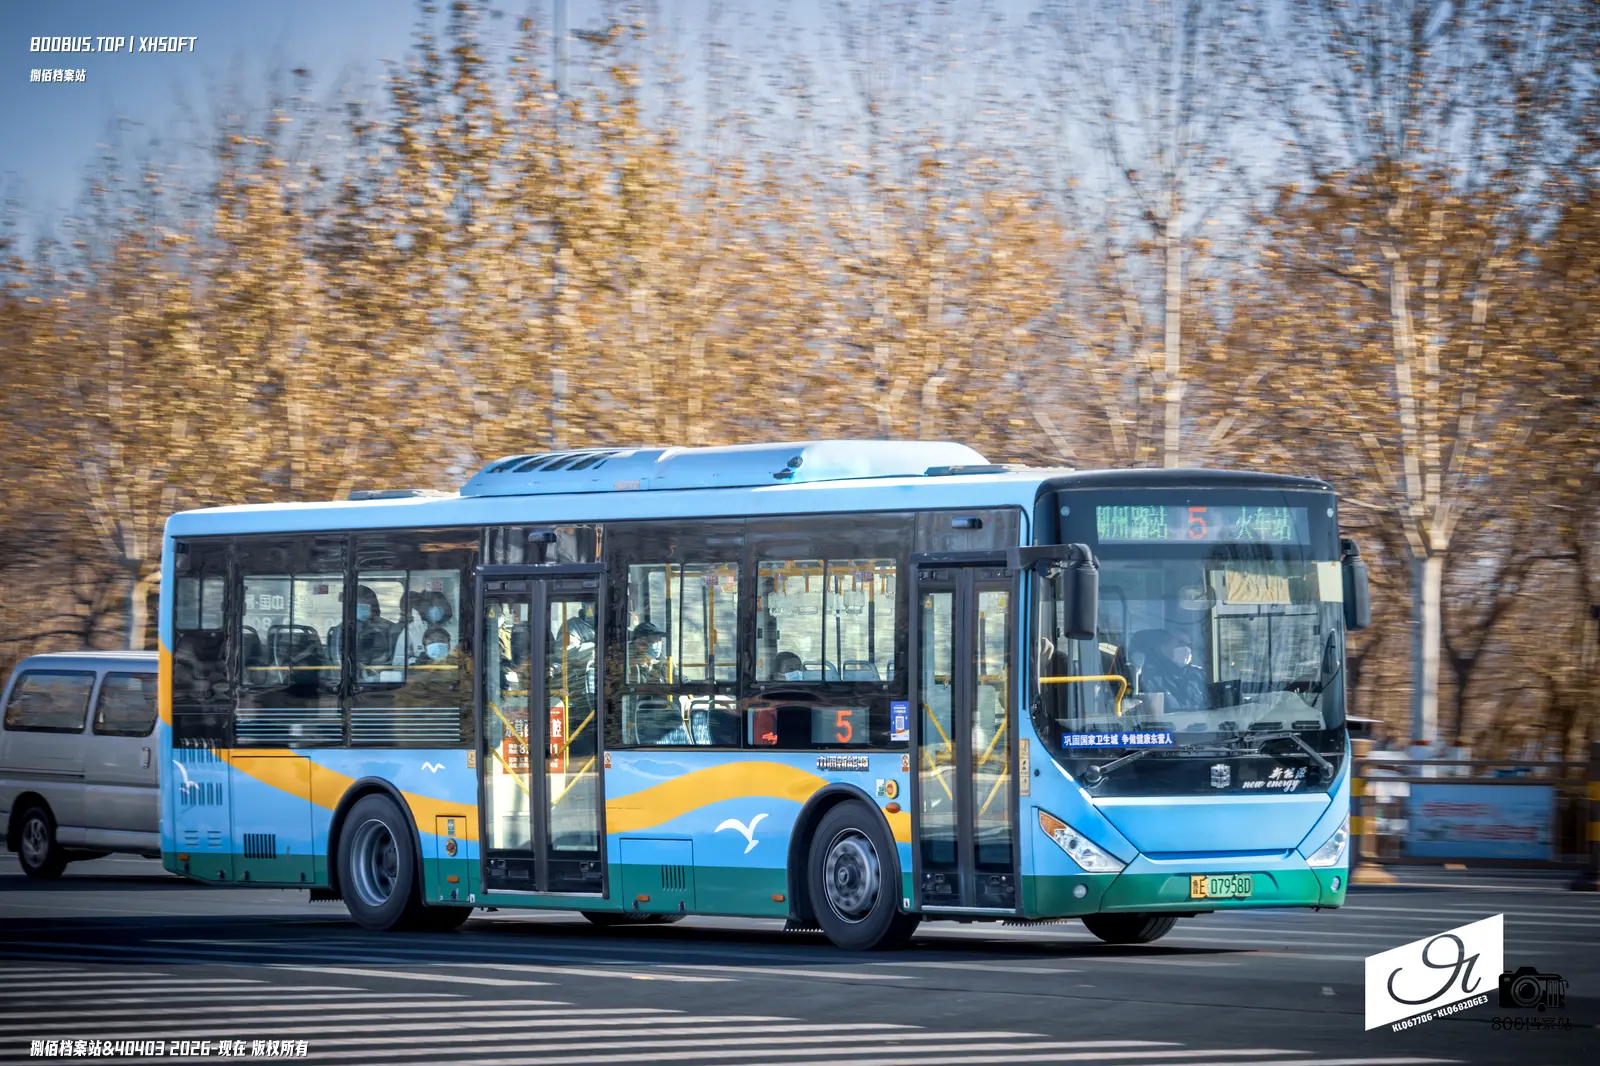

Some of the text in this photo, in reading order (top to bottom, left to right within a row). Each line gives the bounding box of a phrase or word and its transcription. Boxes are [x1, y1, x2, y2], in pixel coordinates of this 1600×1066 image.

[1188, 507, 1208, 540] 5
[1236, 505, 1292, 541] 火车站
[835, 710, 853, 743] 5
[1063, 733, 1173, 746] 巩固国家卫生城 争做健康东营人
[1268, 766, 1308, 779] 新能源
[1242, 779, 1303, 792] new energy
